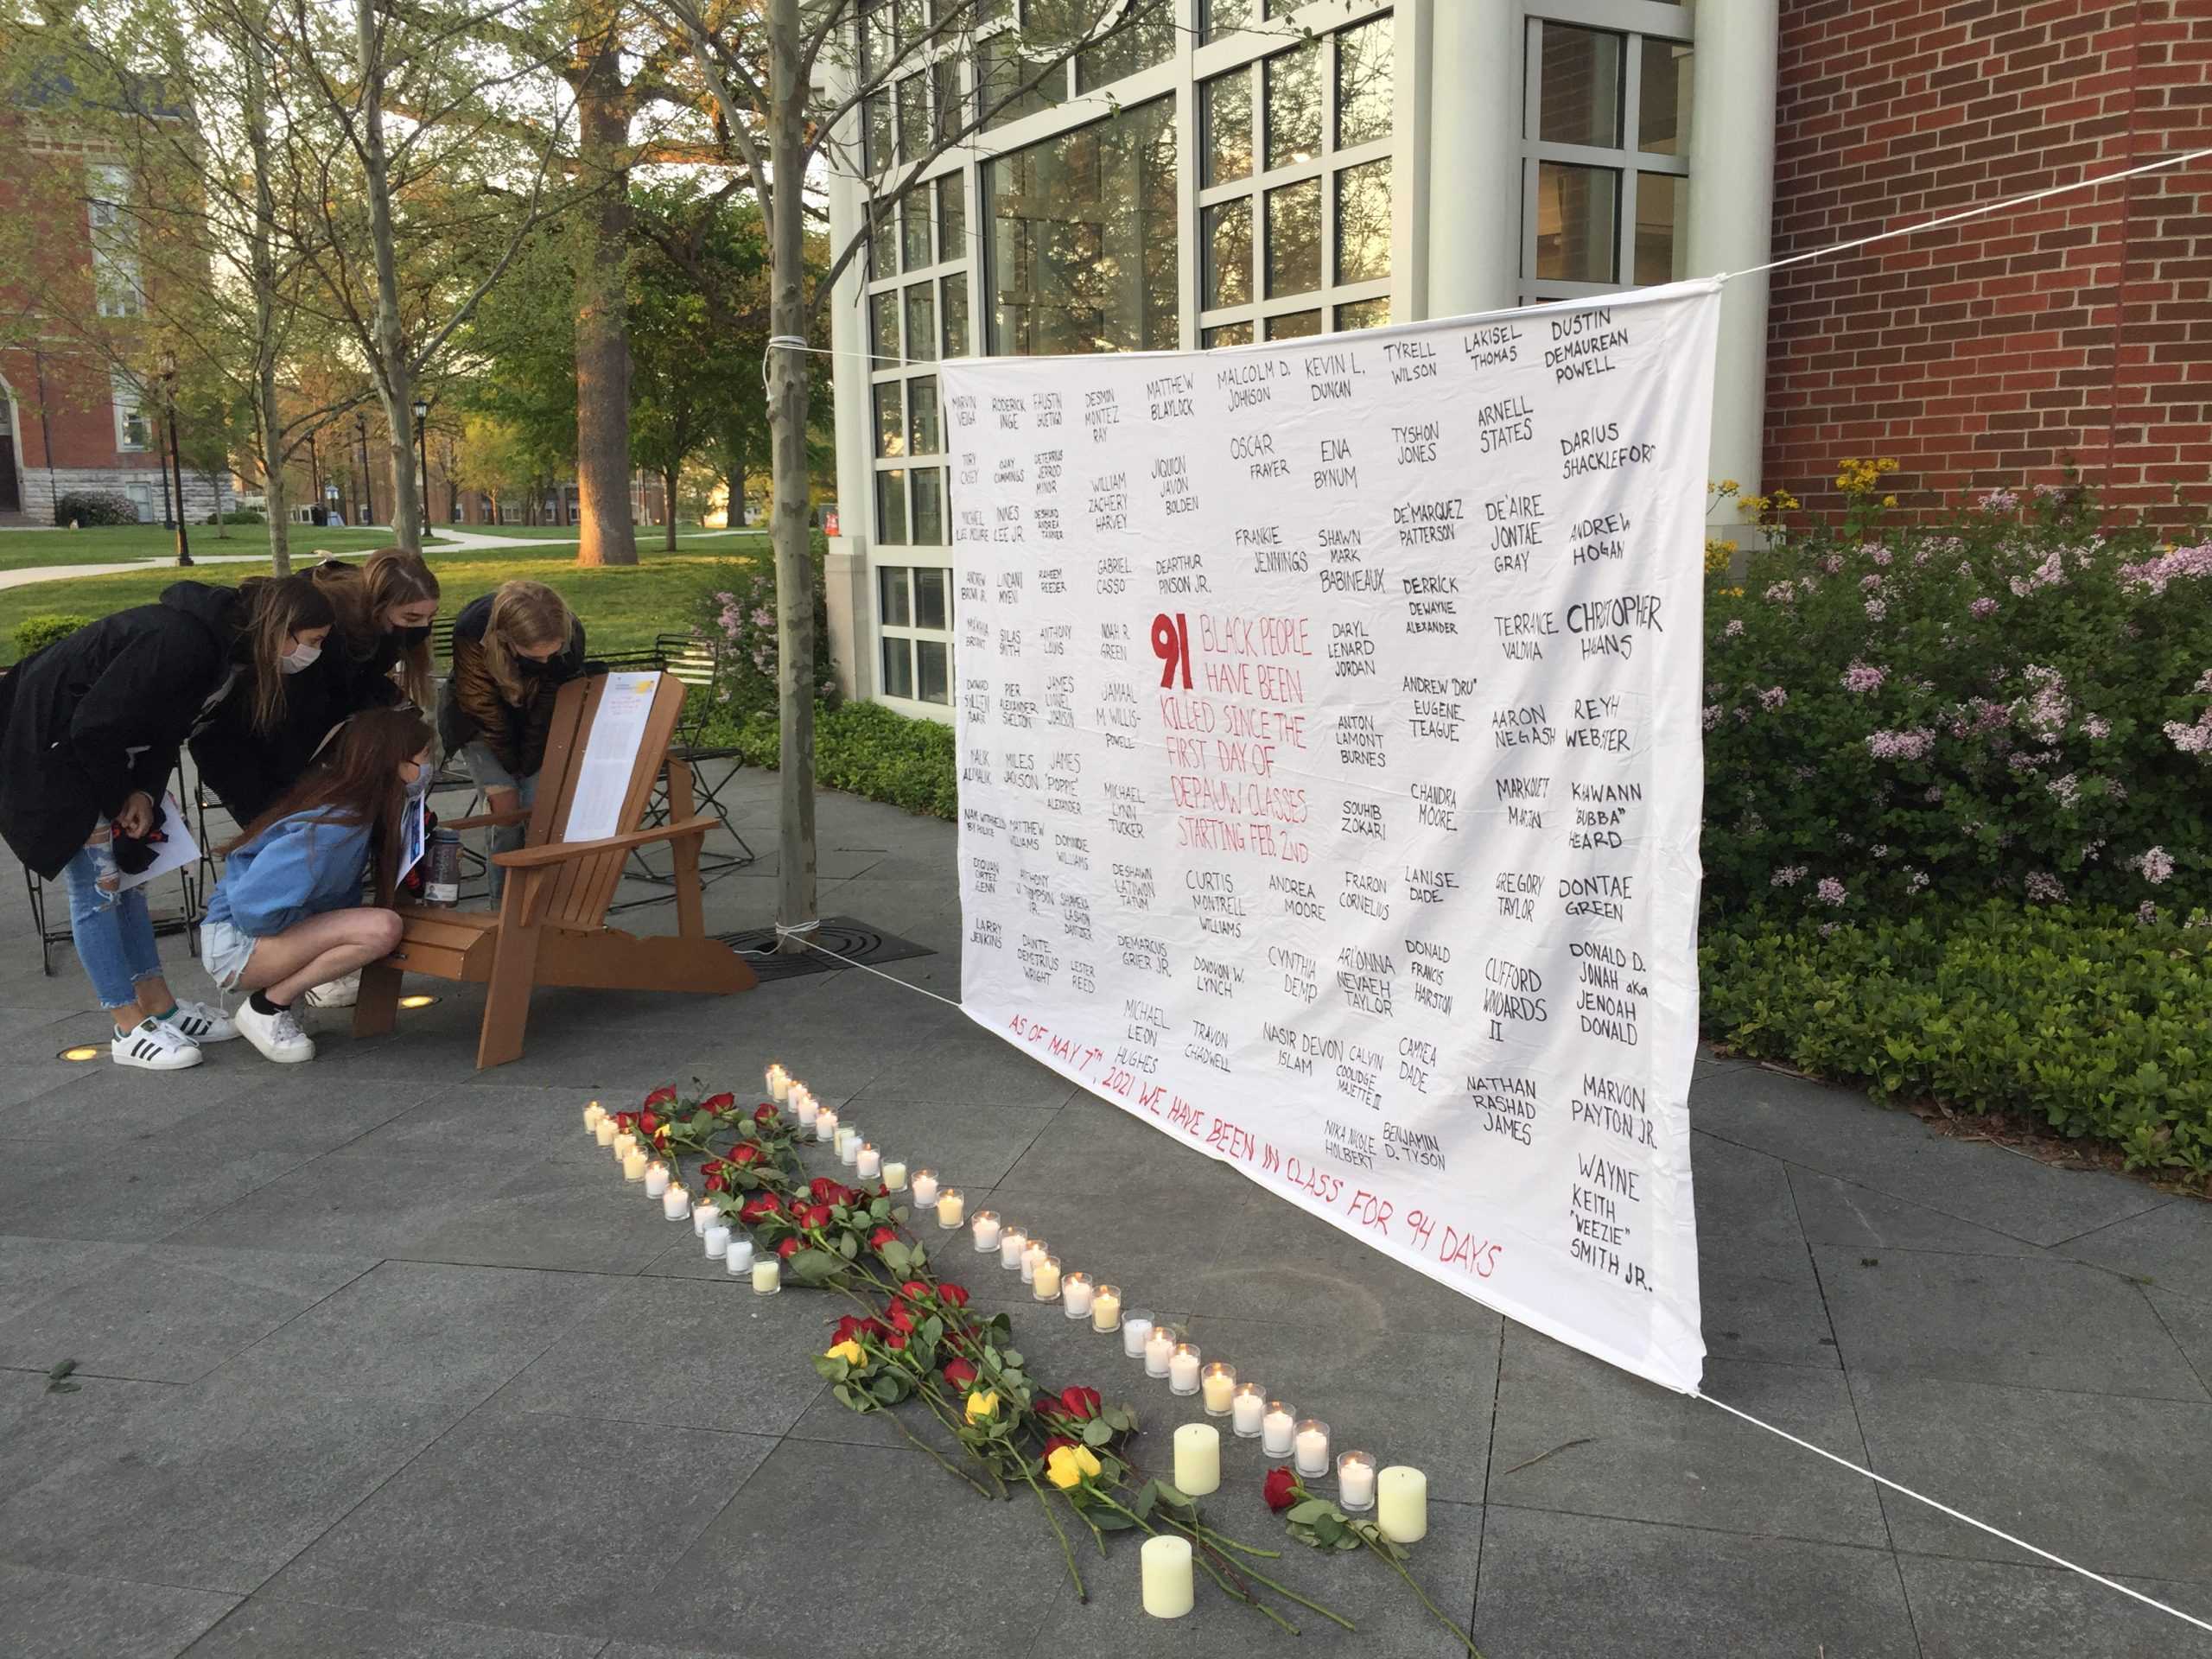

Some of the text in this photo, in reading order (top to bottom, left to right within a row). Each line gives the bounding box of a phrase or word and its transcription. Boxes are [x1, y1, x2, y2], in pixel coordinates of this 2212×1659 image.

[1552, 308, 1611, 341] DUSTIN
[1383, 341, 1436, 363] TYRELL
[1471, 346, 1517, 372] THOMAS
[1544, 328, 1629, 368] DEMAUREAN
[1217, 360, 1274, 389] MALCOLM
[1305, 353, 1346, 378] KEVIN
[1391, 362, 1438, 385] WILSON
[1555, 356, 1616, 384] POWELL
[1147, 373, 1194, 401] MATTHEW
[1228, 387, 1271, 413] JOHNSON
[1311, 380, 1352, 402] DUNCAN
[1478, 396, 1534, 427] ARNELL
[1391, 421, 1440, 444] TYSHON
[1480, 417, 1533, 454] STATES
[1560, 423, 1619, 456] DARIUS
[1230, 434, 1274, 460] OSCAR
[1320, 439, 1352, 462] ENA
[1397, 442, 1437, 465] JONES
[1091, 472, 1127, 493] WILLIAM
[1250, 459, 1291, 480] FRAYER
[1313, 466, 1358, 489] BYNUM
[1166, 496, 1199, 516] BOLDEN
[1096, 514, 1128, 533] HARVEY
[1235, 525, 1282, 546] FRANKIE
[1399, 524, 1456, 546] PATTERSON
[1318, 529, 1361, 547] SHAWN
[1097, 556, 1132, 575] GABRIEL
[1155, 554, 1203, 575] DEARTHUR
[1254, 551, 1309, 574] JENNINGS
[1330, 548, 1361, 563] MARK
[1494, 551, 1529, 573] GRAY
[1573, 540, 1624, 566] HOGAN
[1319, 568, 1386, 594] BABINEAUX
[1402, 575, 1459, 595] DERRICK
[1408, 601, 1457, 616] DEWAYNE
[1199, 614, 1313, 658] BLACK PEOPLE
[1332, 620, 1370, 639] DARYL
[1405, 621, 1459, 635] ALEXANDER
[1151, 613, 1193, 690] 91
[1327, 640, 1376, 659] LENARD
[1334, 659, 1376, 677] JORDAN
[1204, 663, 1304, 704] HAVE BEEN
[1402, 676, 1449, 696] ANDREW
[1160, 695, 1307, 750] KILLED SINCE THE
[1338, 715, 1375, 731] ANTON
[1414, 700, 1465, 722] EUGENE
[1492, 704, 1547, 729] AARON
[1335, 733, 1384, 749] LAMONT
[1408, 719, 1459, 743] TEAGUE
[1166, 736, 1275, 779] FIRST DAY OF
[1340, 749, 1388, 769] BURNES
[1170, 775, 1308, 824] DEPAUW CLASSES
[1342, 799, 1383, 820] SOUHIB
[1418, 804, 1459, 831] MOORE
[1175, 814, 1248, 853] STARTING
[1279, 830, 1310, 865] 2ND
[1569, 830, 1624, 851] HEARD
[1185, 868, 1235, 893] CURTIS
[1268, 874, 1317, 900] ANDREA
[1404, 865, 1459, 890] LANISE
[1558, 874, 1633, 900] DONTAE
[1338, 891, 1390, 921] CORNELIUS
[1408, 887, 1444, 905] DADE
[1284, 898, 1327, 921] MOORE
[1497, 896, 1535, 923] TAYLOR
[1564, 901, 1624, 922] GREEN
[1404, 939, 1452, 964] DONALD
[1568, 941, 1627, 968] DONALD
[1197, 976, 1233, 1000] LYNCH
[1284, 973, 1318, 1004] DEMP
[1485, 957, 1542, 994] CLIFFORD
[1579, 961, 1618, 990] JONAH
[1125, 999, 1171, 1030] MICHAEL
[1344, 990, 1394, 1018] TAYLOR
[1576, 988, 1637, 1021] JENOAH
[1580, 1014, 1638, 1046] DONALD
[1263, 1021, 1384, 1072] NASIR DEVON CALVIN
[1279, 1049, 1313, 1077] ISLAM
[1399, 1060, 1428, 1095] DADE
[1466, 1075, 1536, 1100] NATHAN
[1582, 1073, 1646, 1114] MARVON
[1471, 1094, 1536, 1121] RASHAD
[1571, 1099, 1632, 1140] PAYTON
[1382, 1122, 1440, 1153] BENJAMIN
[1483, 1111, 1532, 1147] JAMES
[1008, 1014, 1028, 1036] AS
[1028, 1023, 1049, 1042] OF
[1047, 1035, 1082, 1064] MAY
[1138, 1080, 1167, 1116] WE
[1167, 1096, 1205, 1137] HAVE
[1205, 1118, 1255, 1161] BEEN
[1262, 1143, 1281, 1173] IN
[1286, 1158, 1344, 1203] CLASS
[1347, 1190, 1395, 1236] FOR
[1406, 1210, 1436, 1251] 94
[1440, 1224, 1503, 1279] DAYS
[1402, 1147, 1446, 1172] TYSON
[1578, 1152, 1640, 1203] WAYNE
[1572, 1182, 1616, 1225] KEITH
[1570, 1237, 1654, 1293] SMITH JR.
